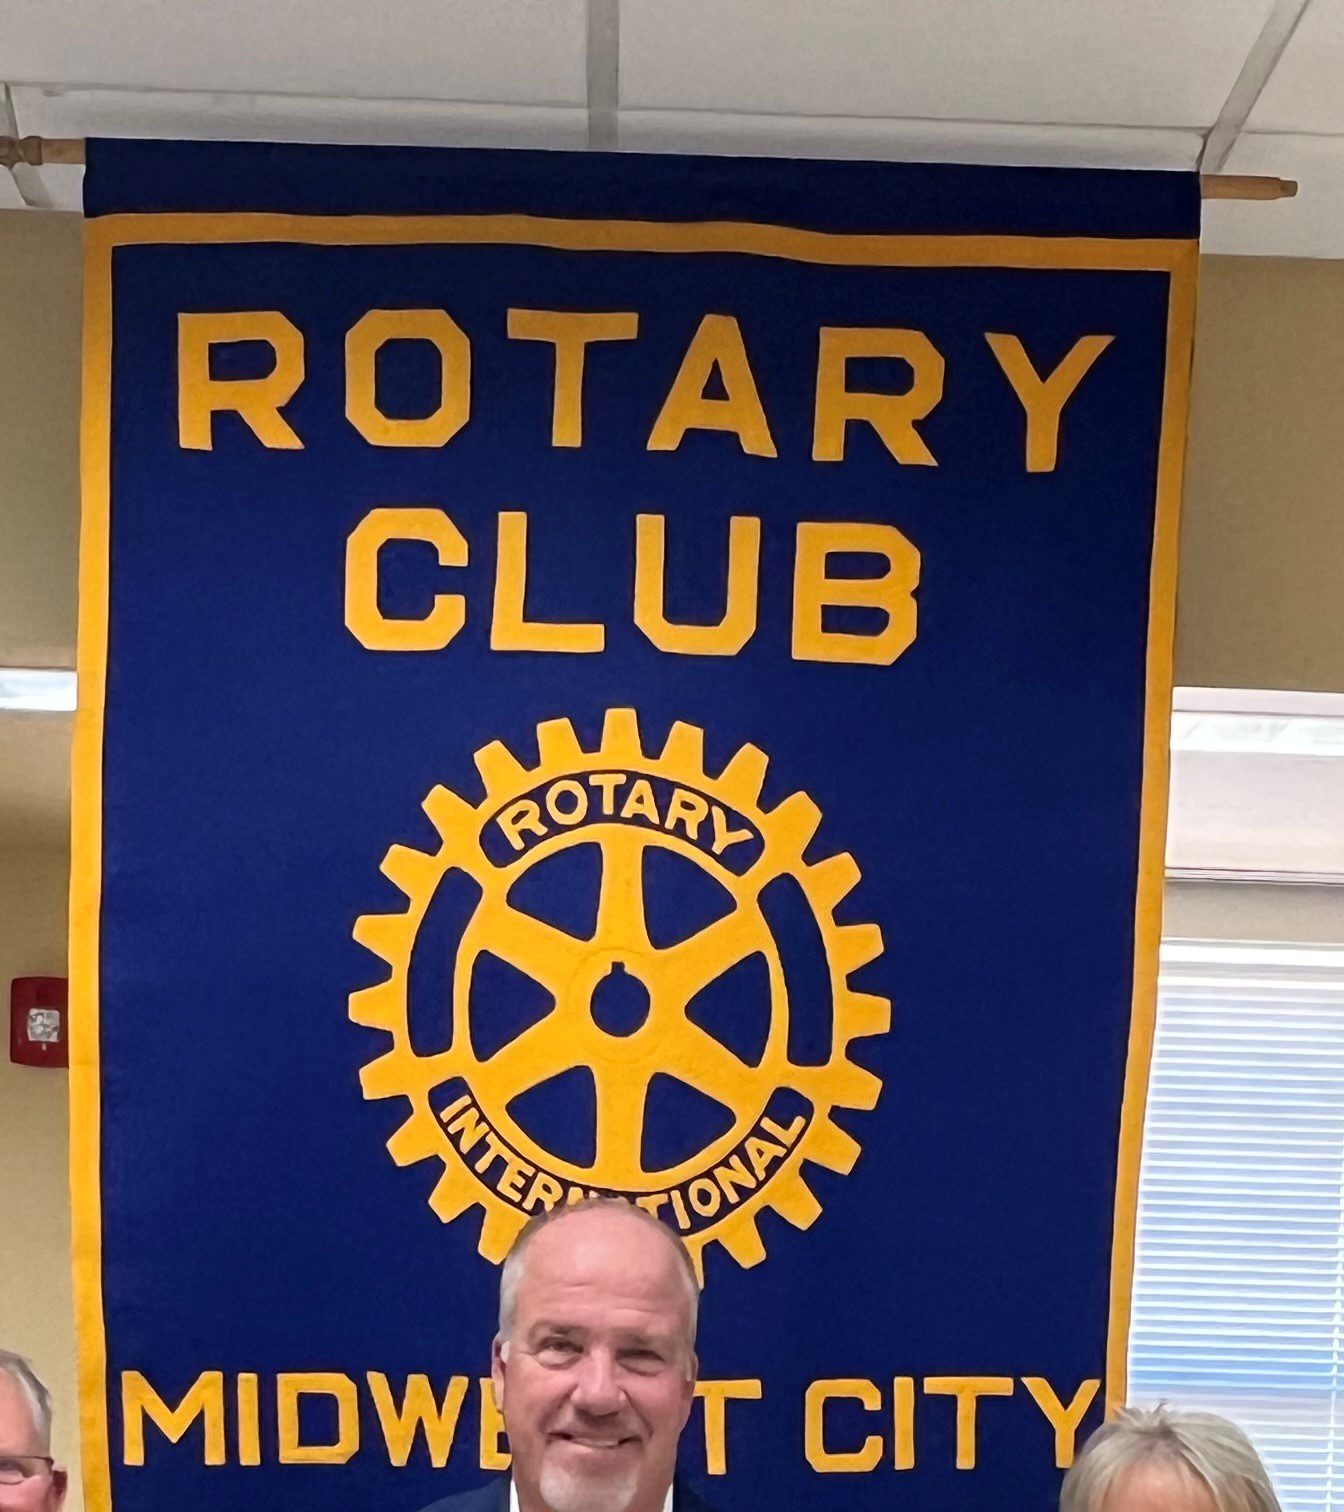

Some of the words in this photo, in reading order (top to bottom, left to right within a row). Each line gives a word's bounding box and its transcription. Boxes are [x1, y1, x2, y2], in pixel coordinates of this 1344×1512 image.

[175, 308, 1118, 477] ROTARY
[342, 506, 924, 668] CLUB
[496, 773, 754, 855] ROTARY
[439, 1093, 806, 1217] INTERTIONAL
[804, 1376, 1102, 1474] CITY
